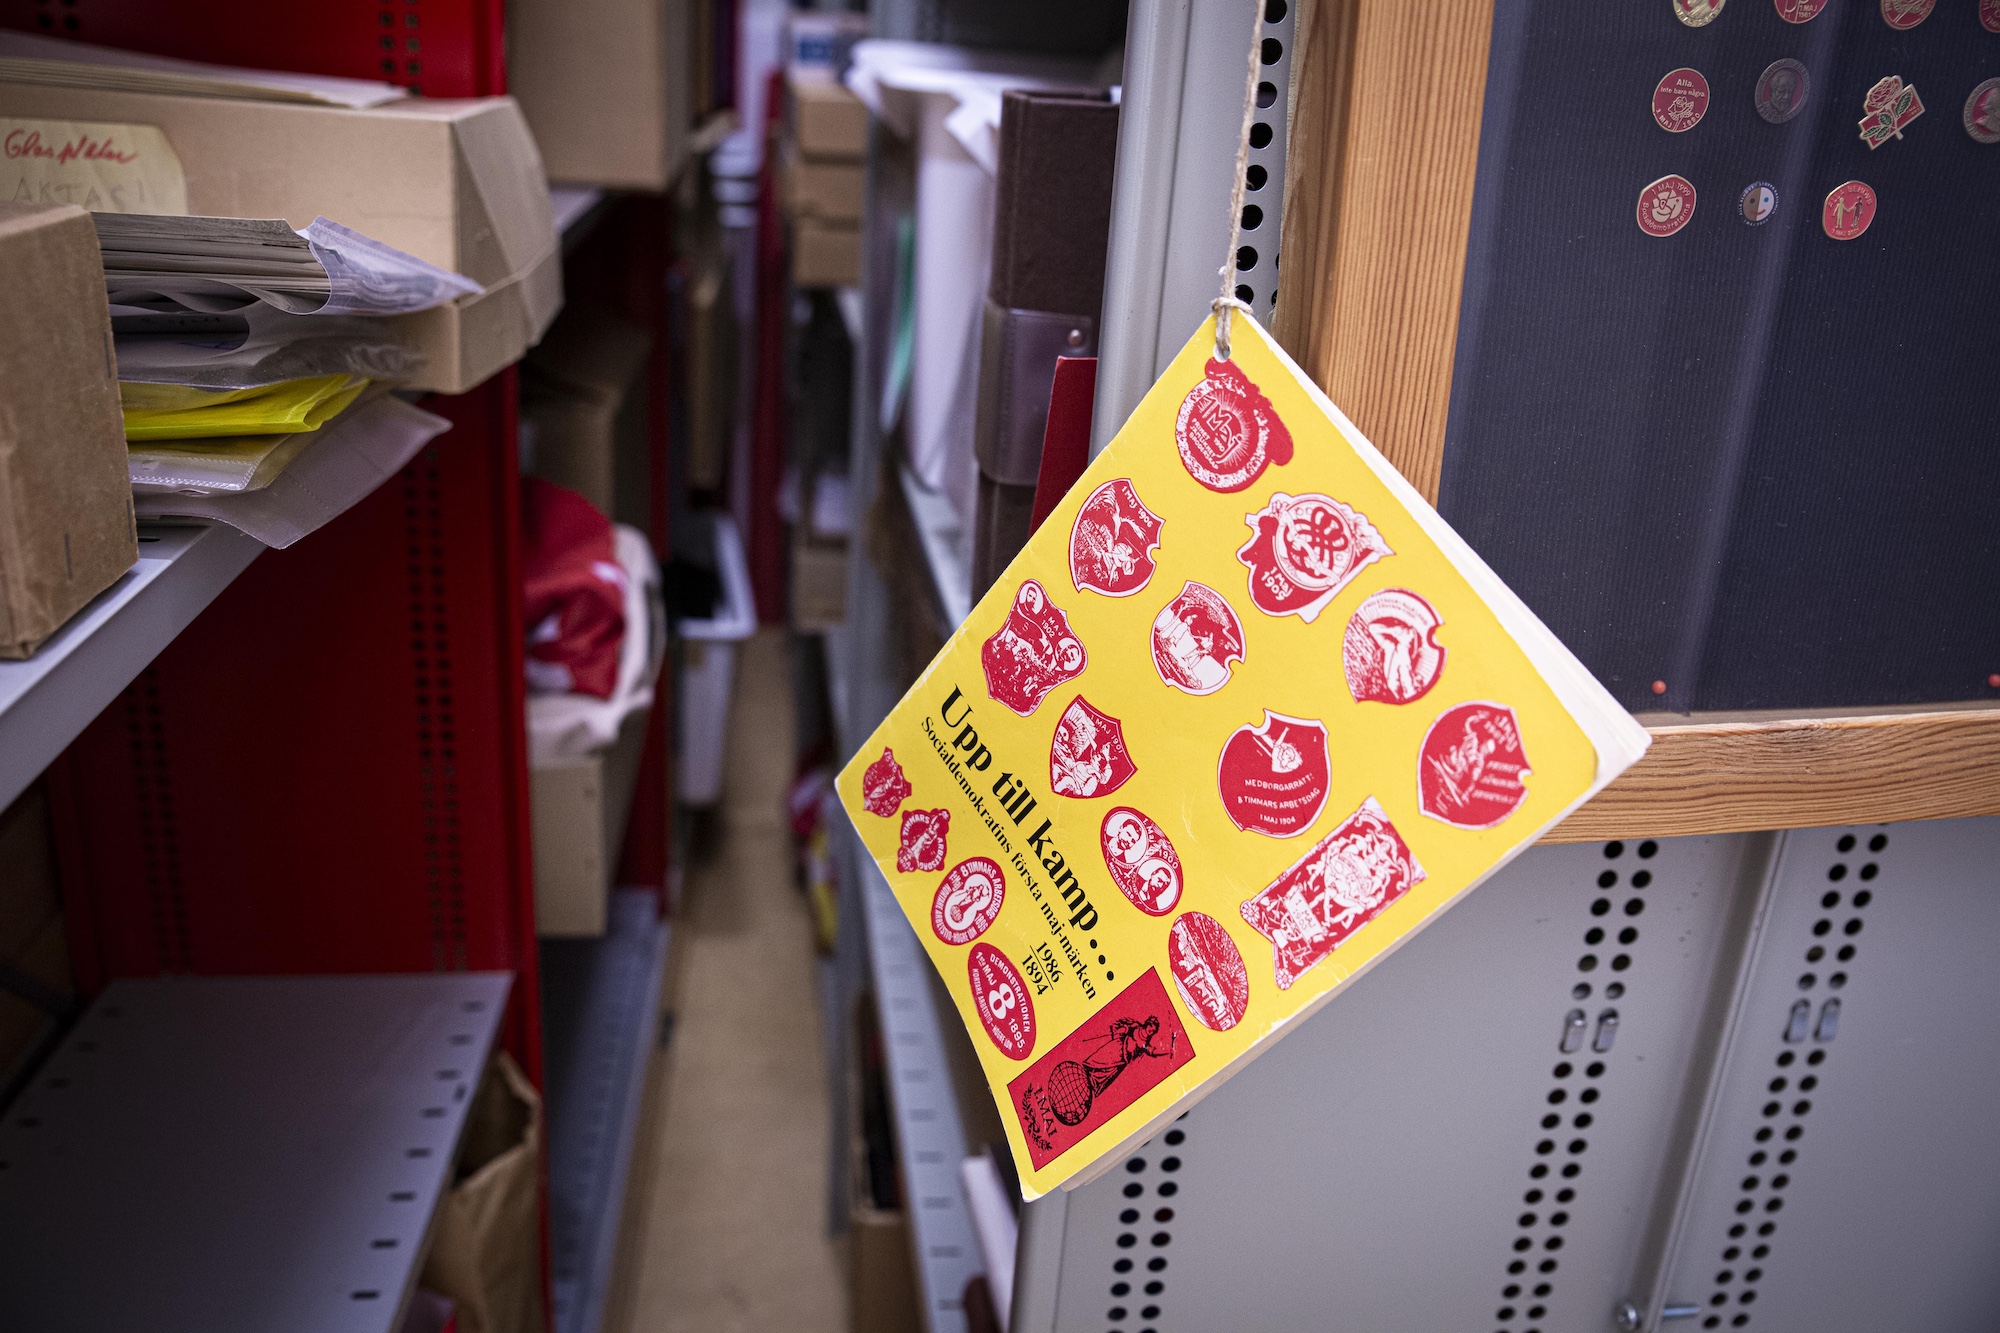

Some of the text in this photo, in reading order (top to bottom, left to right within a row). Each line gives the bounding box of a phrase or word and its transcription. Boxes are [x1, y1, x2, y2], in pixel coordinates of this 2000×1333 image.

[1676, 79, 1694, 88] Alla.
[1659, 115, 1673, 128] MAJ
[1657, 181, 1675, 192] MAJ
[1124, 491, 1139, 509] MAJ
[1137, 507, 1154, 528] 1906
[1041, 619, 1056, 639] 1902
[1048, 616, 1064, 638] MAJ
[1095, 718, 1111, 735] MAJ
[1111, 734, 1124, 754] 1901
[940, 683, 992, 772] Upp
[991, 771, 1037, 828] till
[1244, 795, 1278, 809] TIMMARS
[1279, 787, 1321, 809] ARBETSDAG
[1264, 815, 1278, 825] MAJ
[1279, 815, 1296, 825] 1904
[902, 814, 930, 836] TIMMARS
[919, 837, 945, 871] ARBETSDAG
[921, 716, 1098, 1001] Socialdemokratins första maj-märken
[1159, 848, 1179, 869] 1900
[960, 861, 1003, 920] 8 TIMMARS ARBETSDAG
[982, 964, 998, 986] MAJ
[1021, 954, 1049, 996] 1894
[1035, 941, 1064, 984] 1986
[988, 982, 1016, 1020] 8
[990, 953, 1030, 1033] DEMONSTRATIONEN
